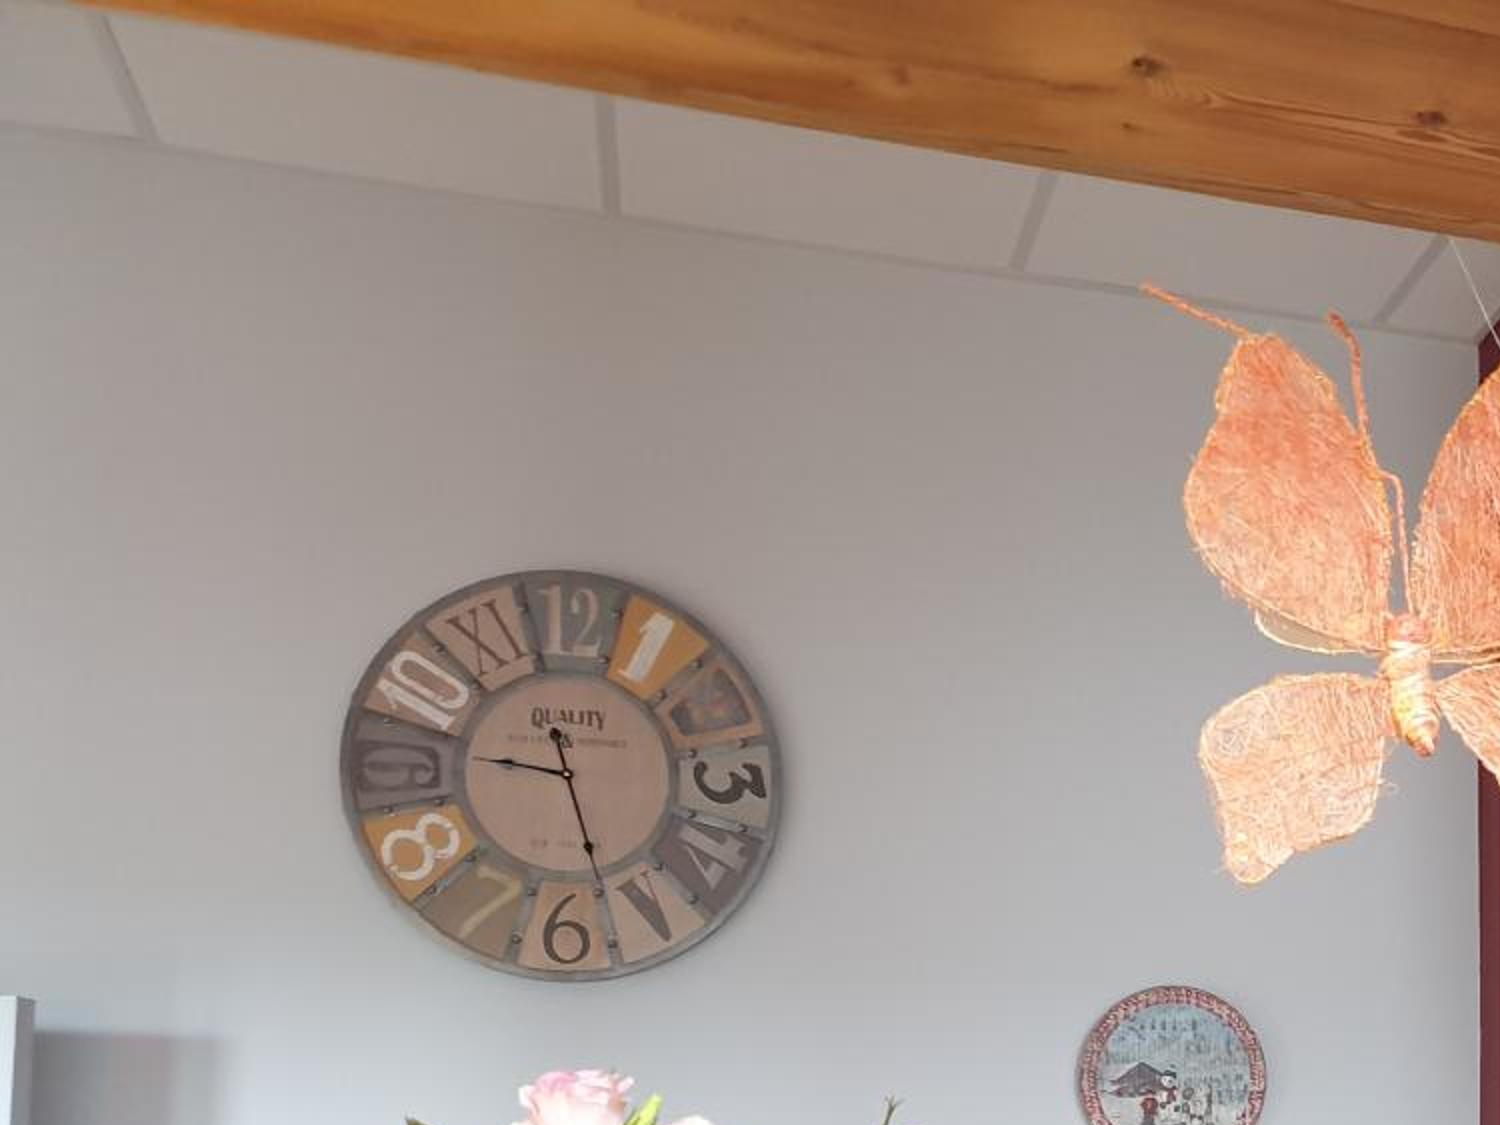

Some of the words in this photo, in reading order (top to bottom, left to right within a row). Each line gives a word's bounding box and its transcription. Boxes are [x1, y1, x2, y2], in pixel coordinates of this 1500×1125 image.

[446, 597, 530, 678] XI
[540, 582, 603, 658] 12
[618, 610, 676, 683] 1
[374, 649, 470, 733] 10
[531, 706, 606, 731] QUALITY
[692, 760, 768, 806] 3
[379, 811, 462, 881] 8
[680, 825, 752, 890] 4
[542, 892, 592, 966] 6
